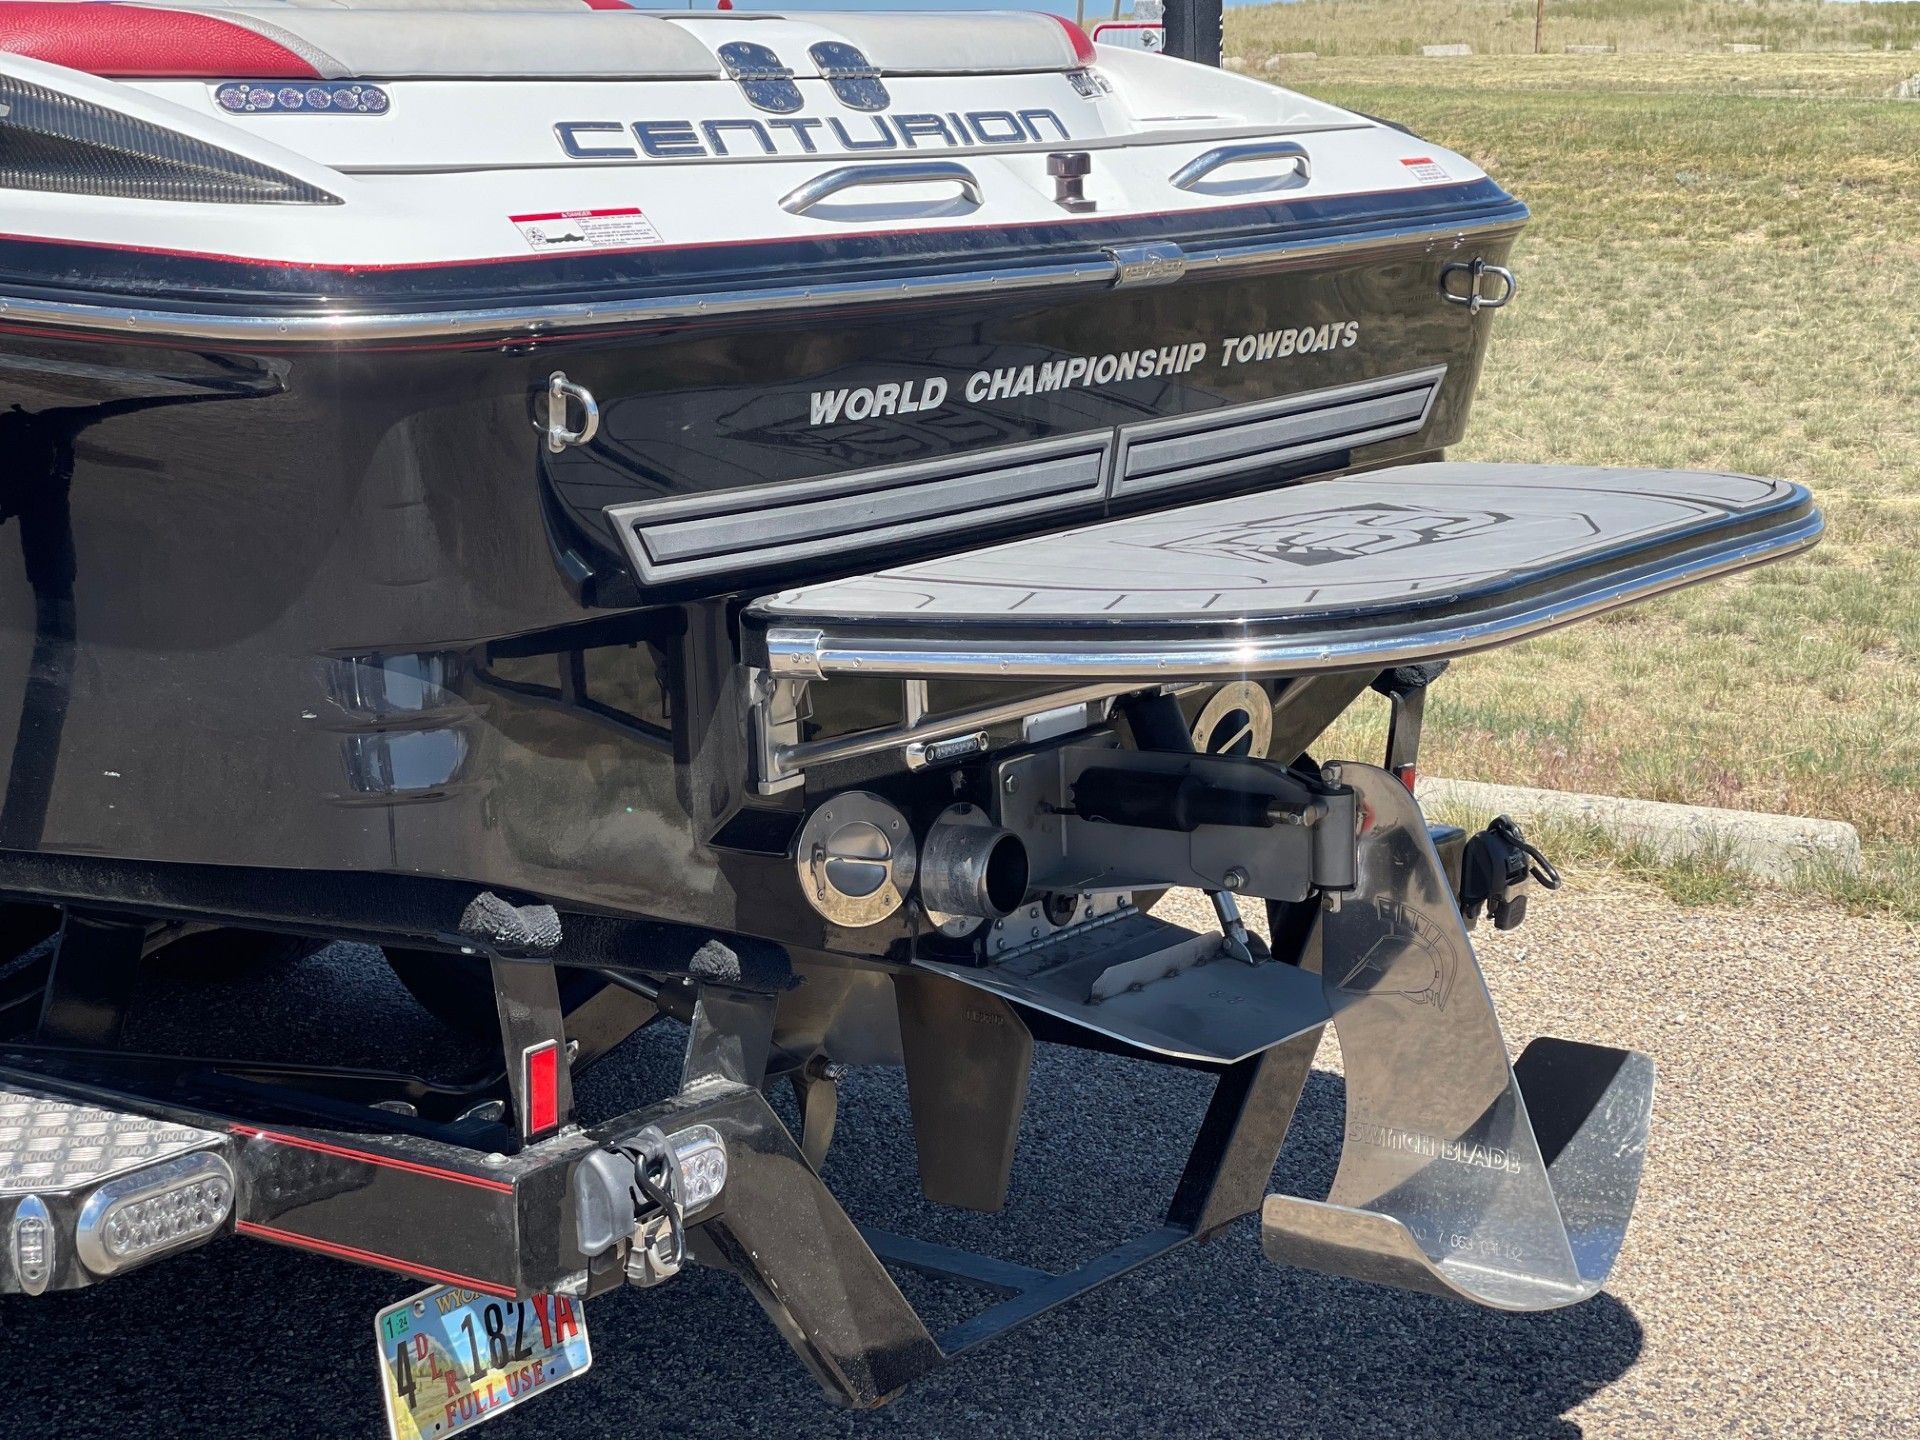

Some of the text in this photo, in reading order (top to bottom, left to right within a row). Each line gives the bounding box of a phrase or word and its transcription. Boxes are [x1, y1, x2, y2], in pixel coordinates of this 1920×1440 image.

[553, 109, 1071, 159] CENTURION
[810, 320, 1359, 425] WORLD CHAMPIONSHIP TOWBOATS
[1349, 1121, 1521, 1174] SWITCH BLADE
[397, 1341, 417, 1410] 4
[444, 1359, 546, 1428] FULL USE
